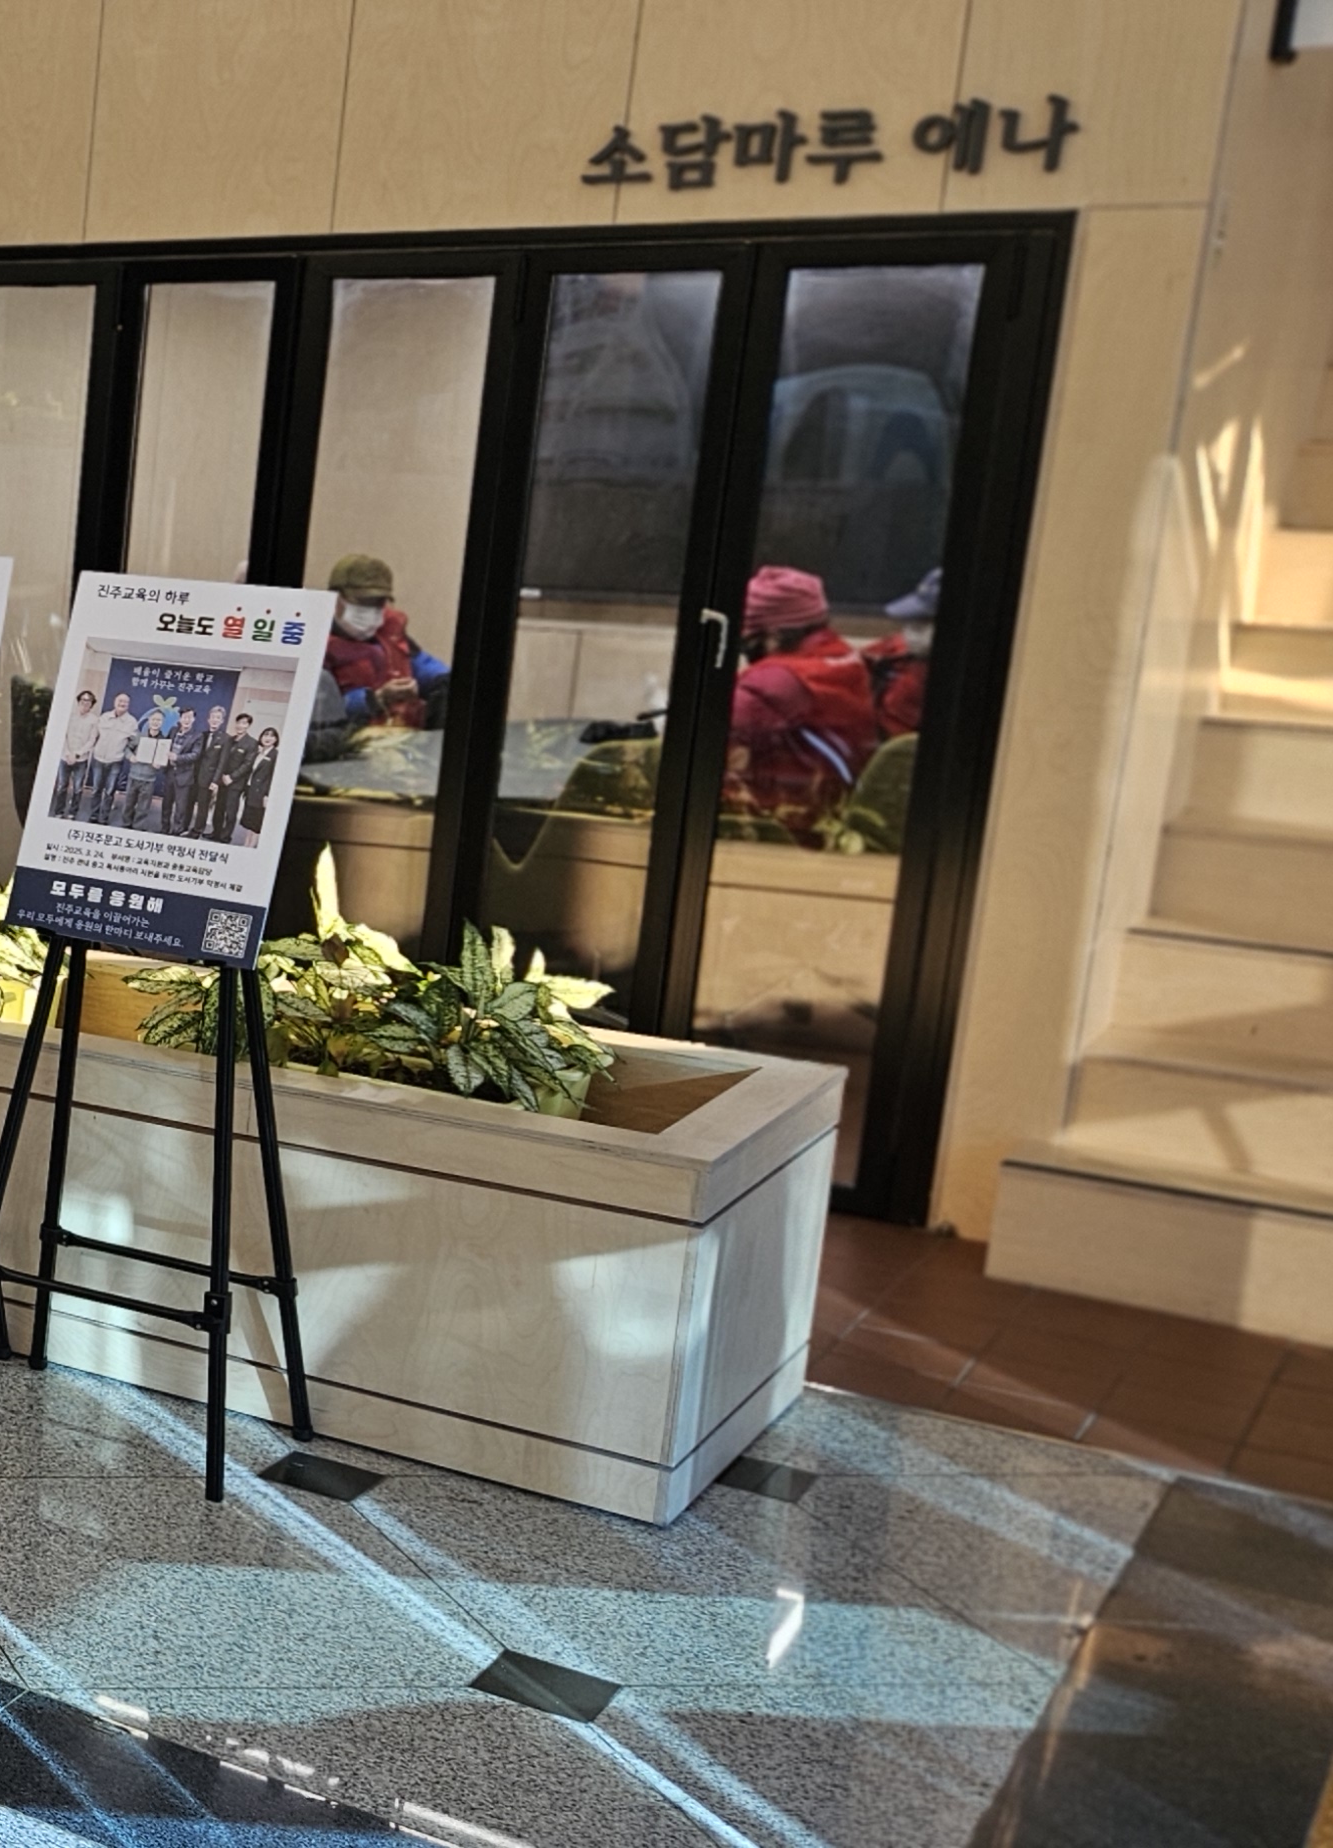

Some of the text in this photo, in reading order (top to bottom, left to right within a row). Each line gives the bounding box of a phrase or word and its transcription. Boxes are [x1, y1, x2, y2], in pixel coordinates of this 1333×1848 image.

[580, 109, 884, 191] 소담마루
[97, 584, 190, 606] 진주교육의 하루
[156, 612, 215, 636] 오늘도
[67, 828, 229, 865] (주)진주문고 도서기부 약정서 전달식
[49, 880, 165, 914] 모두를 응원해
